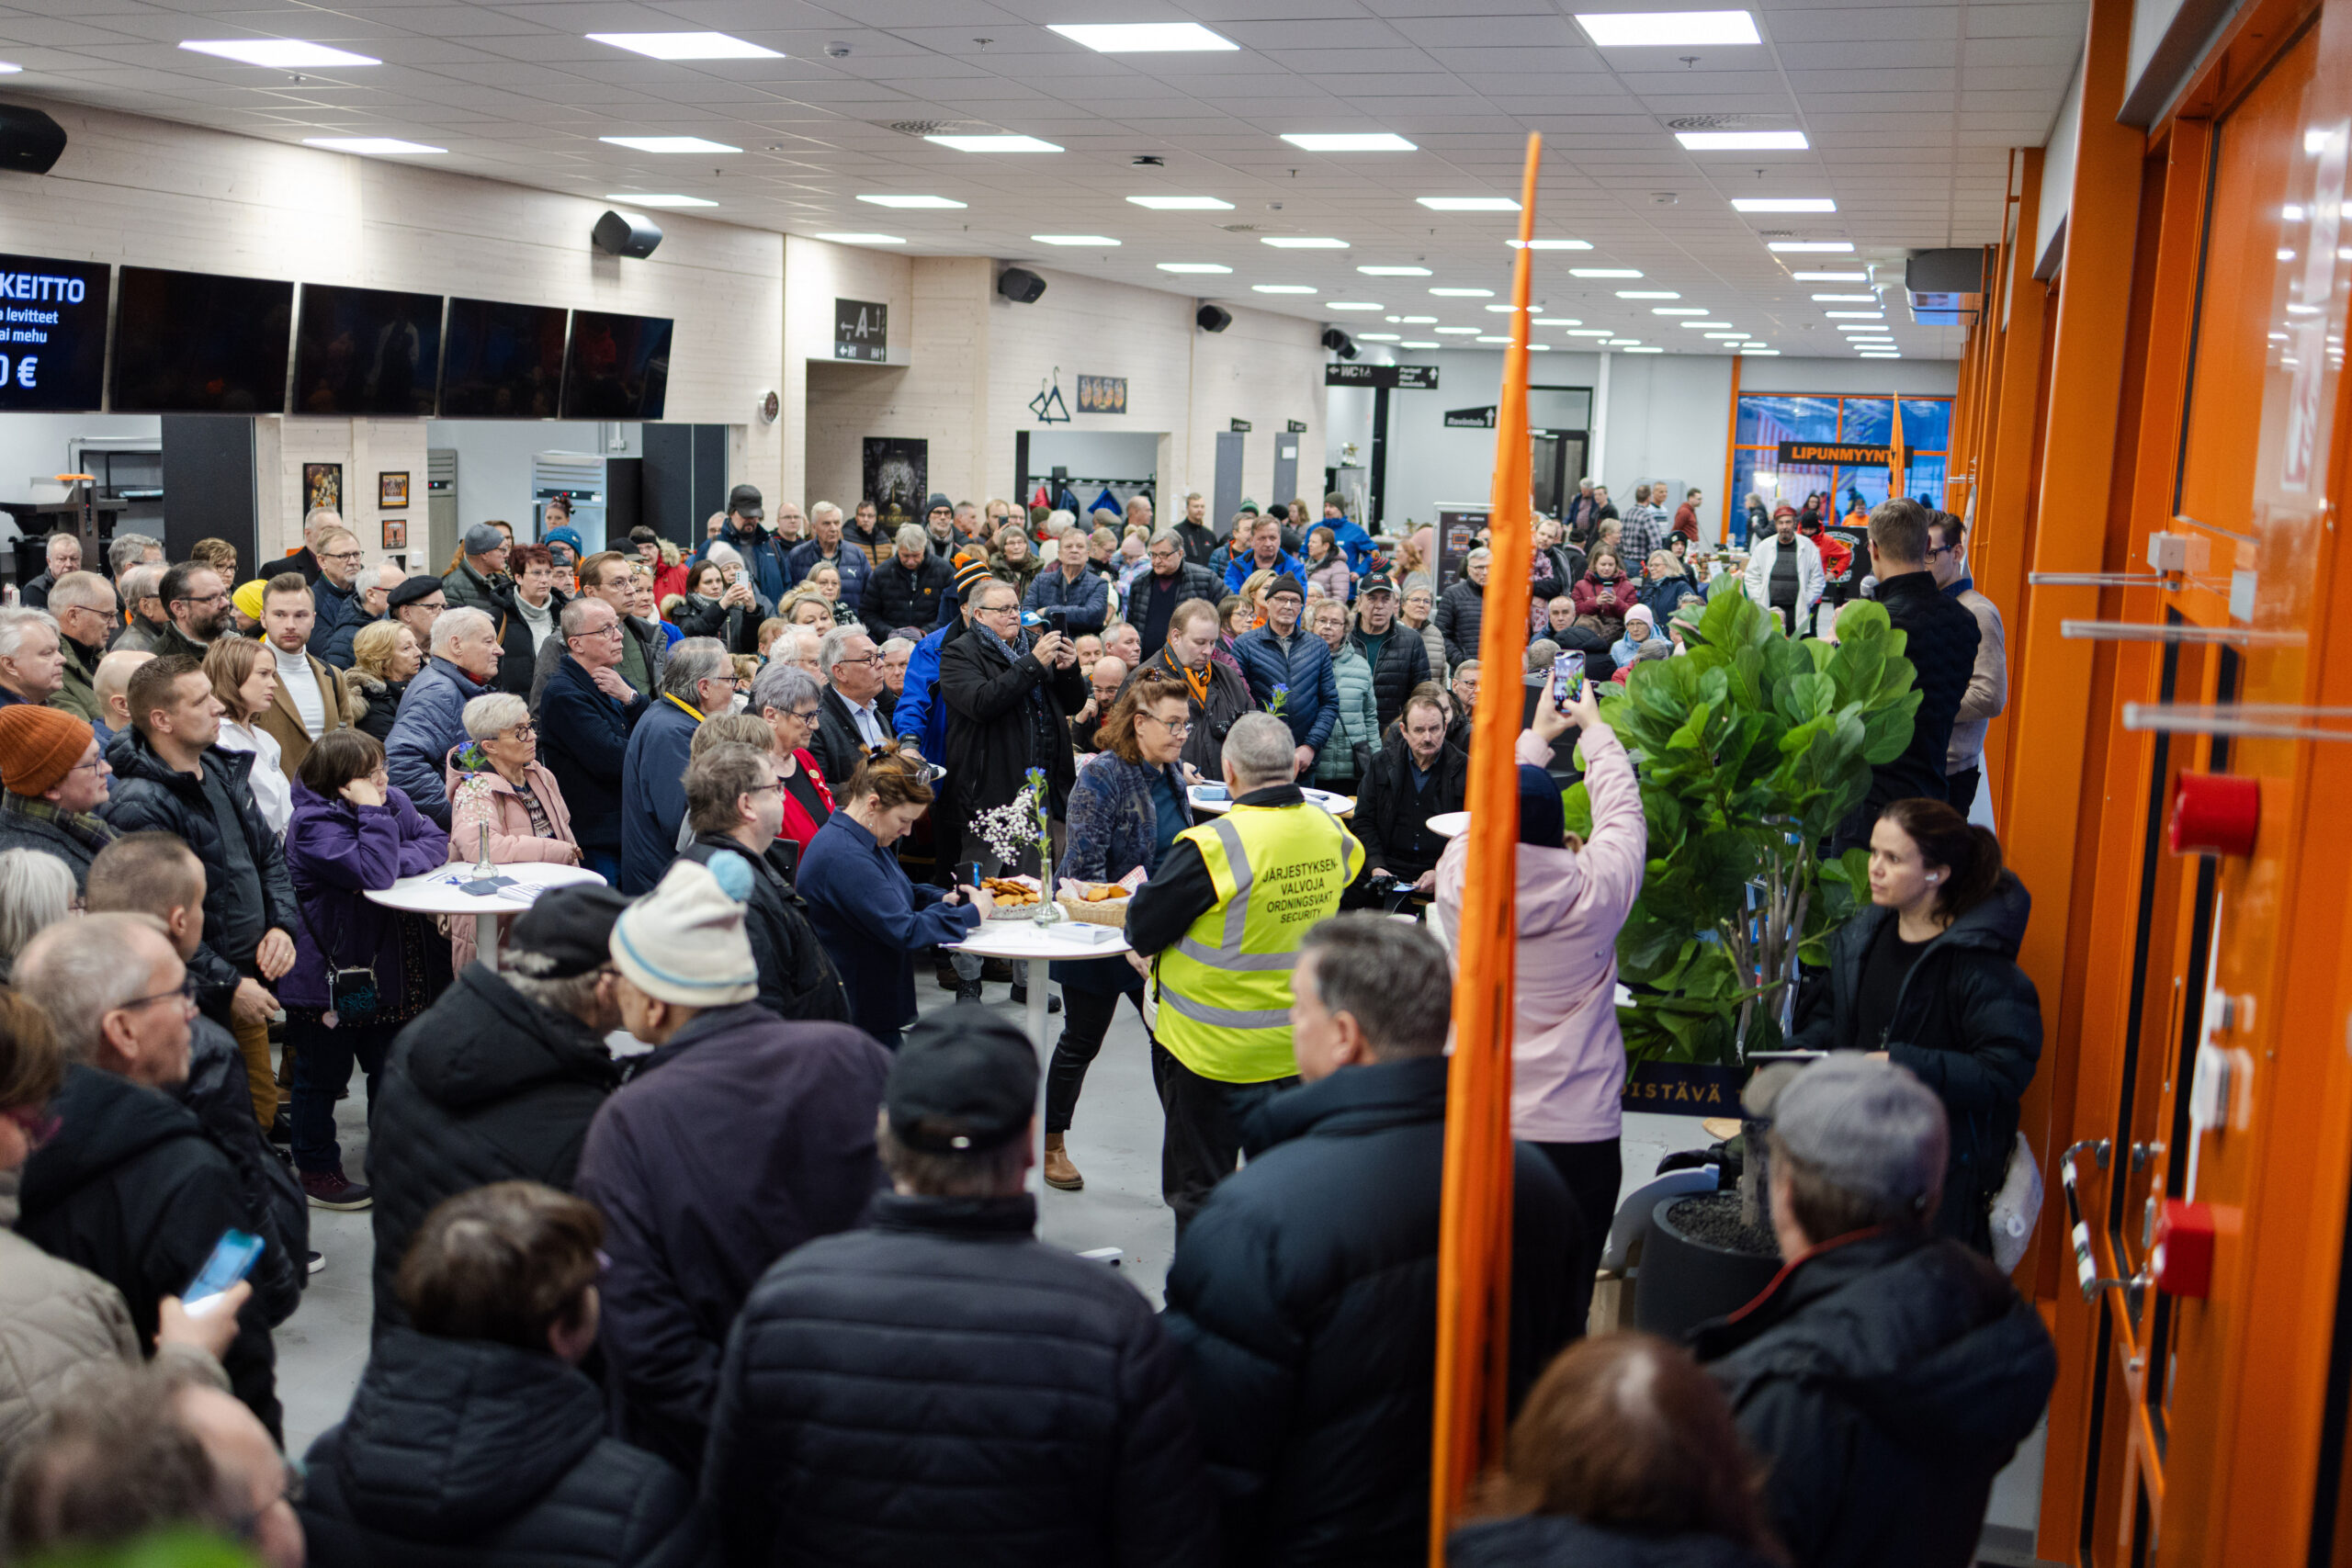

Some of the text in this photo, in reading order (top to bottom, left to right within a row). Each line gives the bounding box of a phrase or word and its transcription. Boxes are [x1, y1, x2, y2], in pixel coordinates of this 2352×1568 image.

[0, 273, 85, 303] KEITTO
[6, 307, 59, 324] levitteet
[855, 307, 868, 339] A
[13, 329, 48, 344] mehu
[17, 356, 39, 388] €
[1341, 366, 1358, 378] WC
[1792, 446, 1892, 463] LIPUNMYYNT
[1262, 857, 1339, 883] JÄRJESTYKSEN-
[1281, 878, 1325, 896] VALVOJA
[1267, 891, 1333, 913] ORDNINGSVAKT
[1280, 908, 1322, 924] SECURITY
